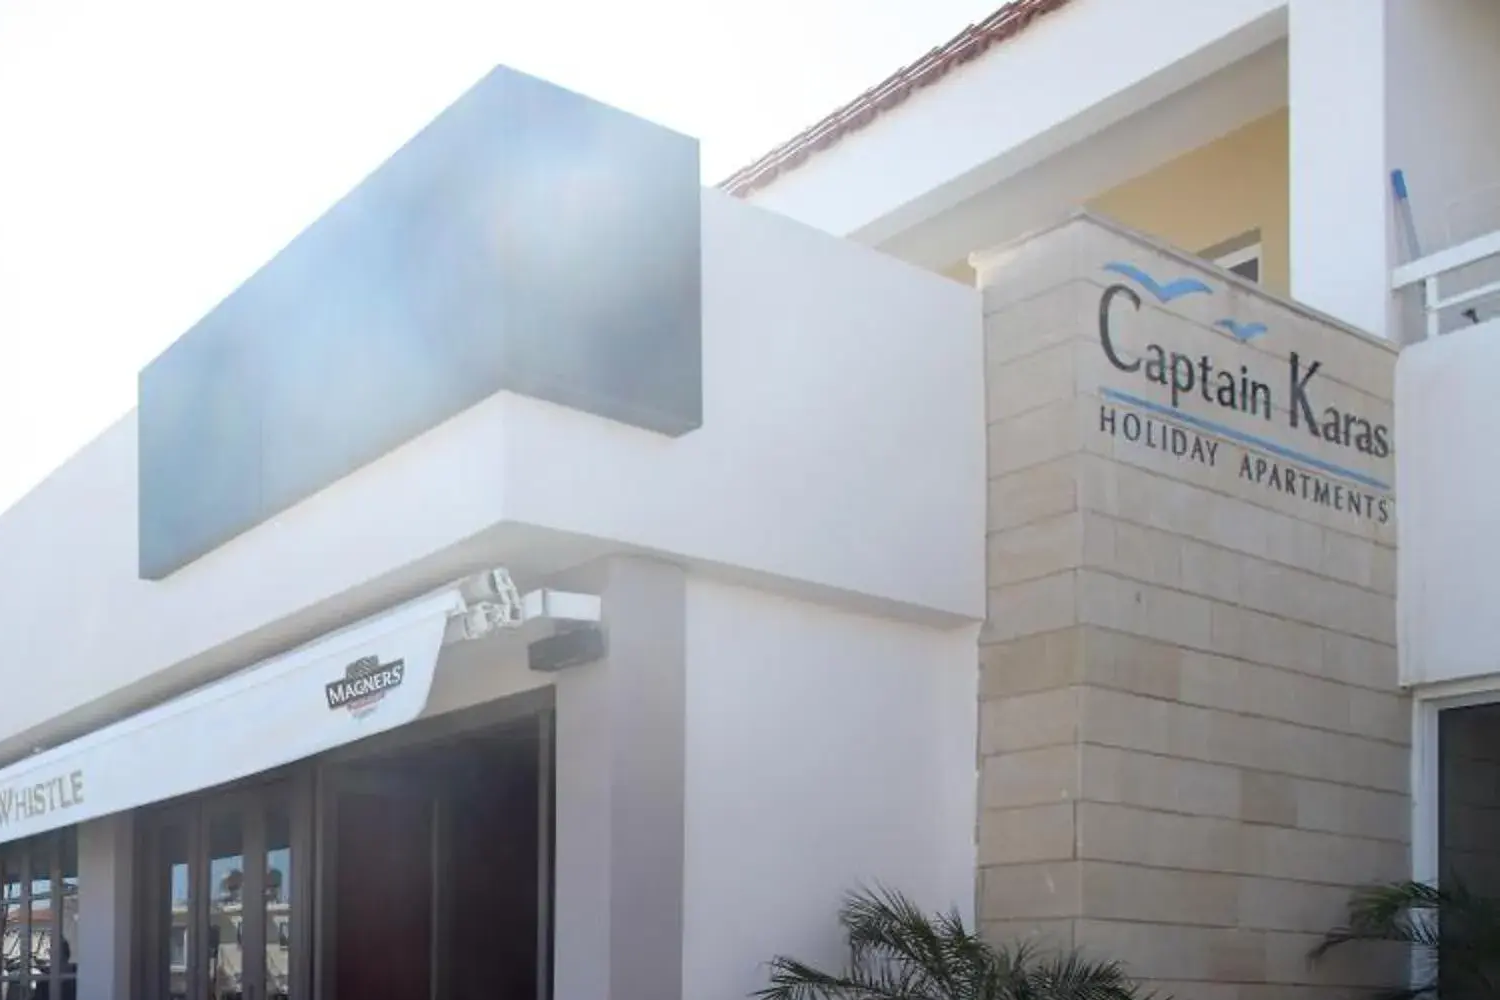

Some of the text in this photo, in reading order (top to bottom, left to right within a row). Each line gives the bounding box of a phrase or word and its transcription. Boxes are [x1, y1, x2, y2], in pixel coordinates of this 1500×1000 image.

[1099, 284, 1389, 458] Captain Karas
[1100, 406, 1389, 526] HOLIDAY APARTMENTS
[328, 664, 402, 705] MAGNERS
